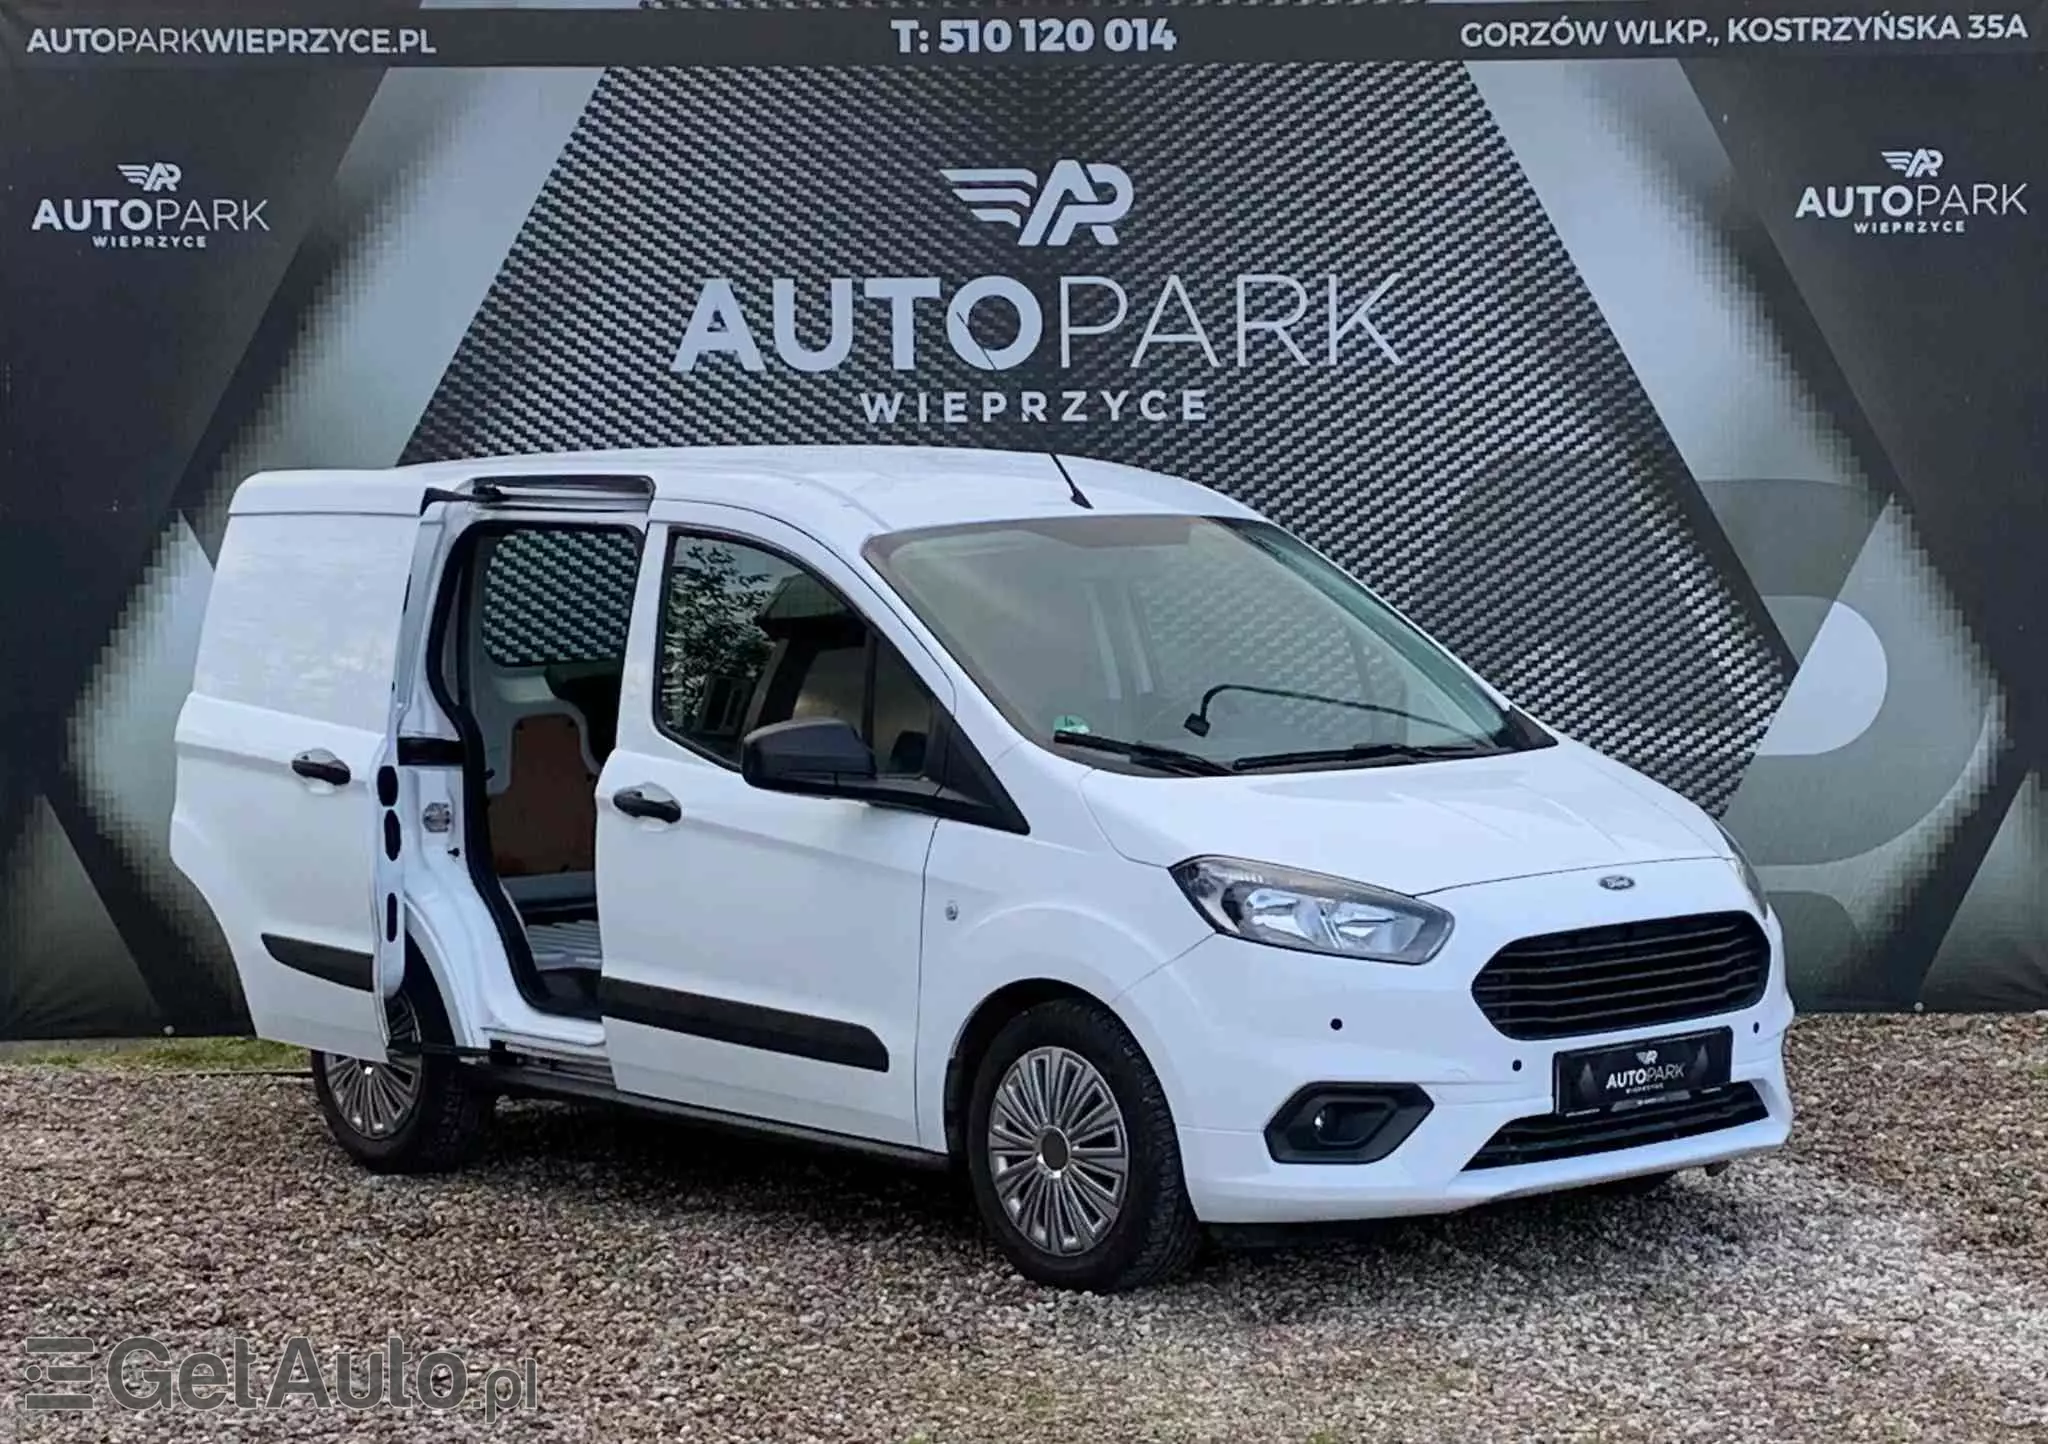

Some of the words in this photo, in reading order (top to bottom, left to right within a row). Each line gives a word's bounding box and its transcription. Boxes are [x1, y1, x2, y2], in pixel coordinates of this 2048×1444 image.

[26, 27, 437, 54] AUTOPARKWIEPRZYCE.PL
[890, 19, 929, 53] T:
[938, 19, 1012, 53] 510
[1019, 18, 1094, 52] 120
[1103, 18, 1178, 52] 014
[1460, 15, 1609, 47] GORZÓW
[1614, 19, 1720, 47] WLKP.,
[1727, 10, 1961, 43] KOSTRZYŃSKA
[1966, 13, 2029, 40] 35A
[31, 198, 270, 231] AUTOPARK
[1794, 182, 2028, 219] AUTOPARK
[92, 235, 207, 248] WIEPRZYCE
[1853, 220, 1965, 234] WIEPRZYCE
[670, 273, 1404, 373] AUTOPARK
[860, 389, 1208, 424] WIEPRZYCE
[1605, 1062, 1686, 1090] AUTOPARK
